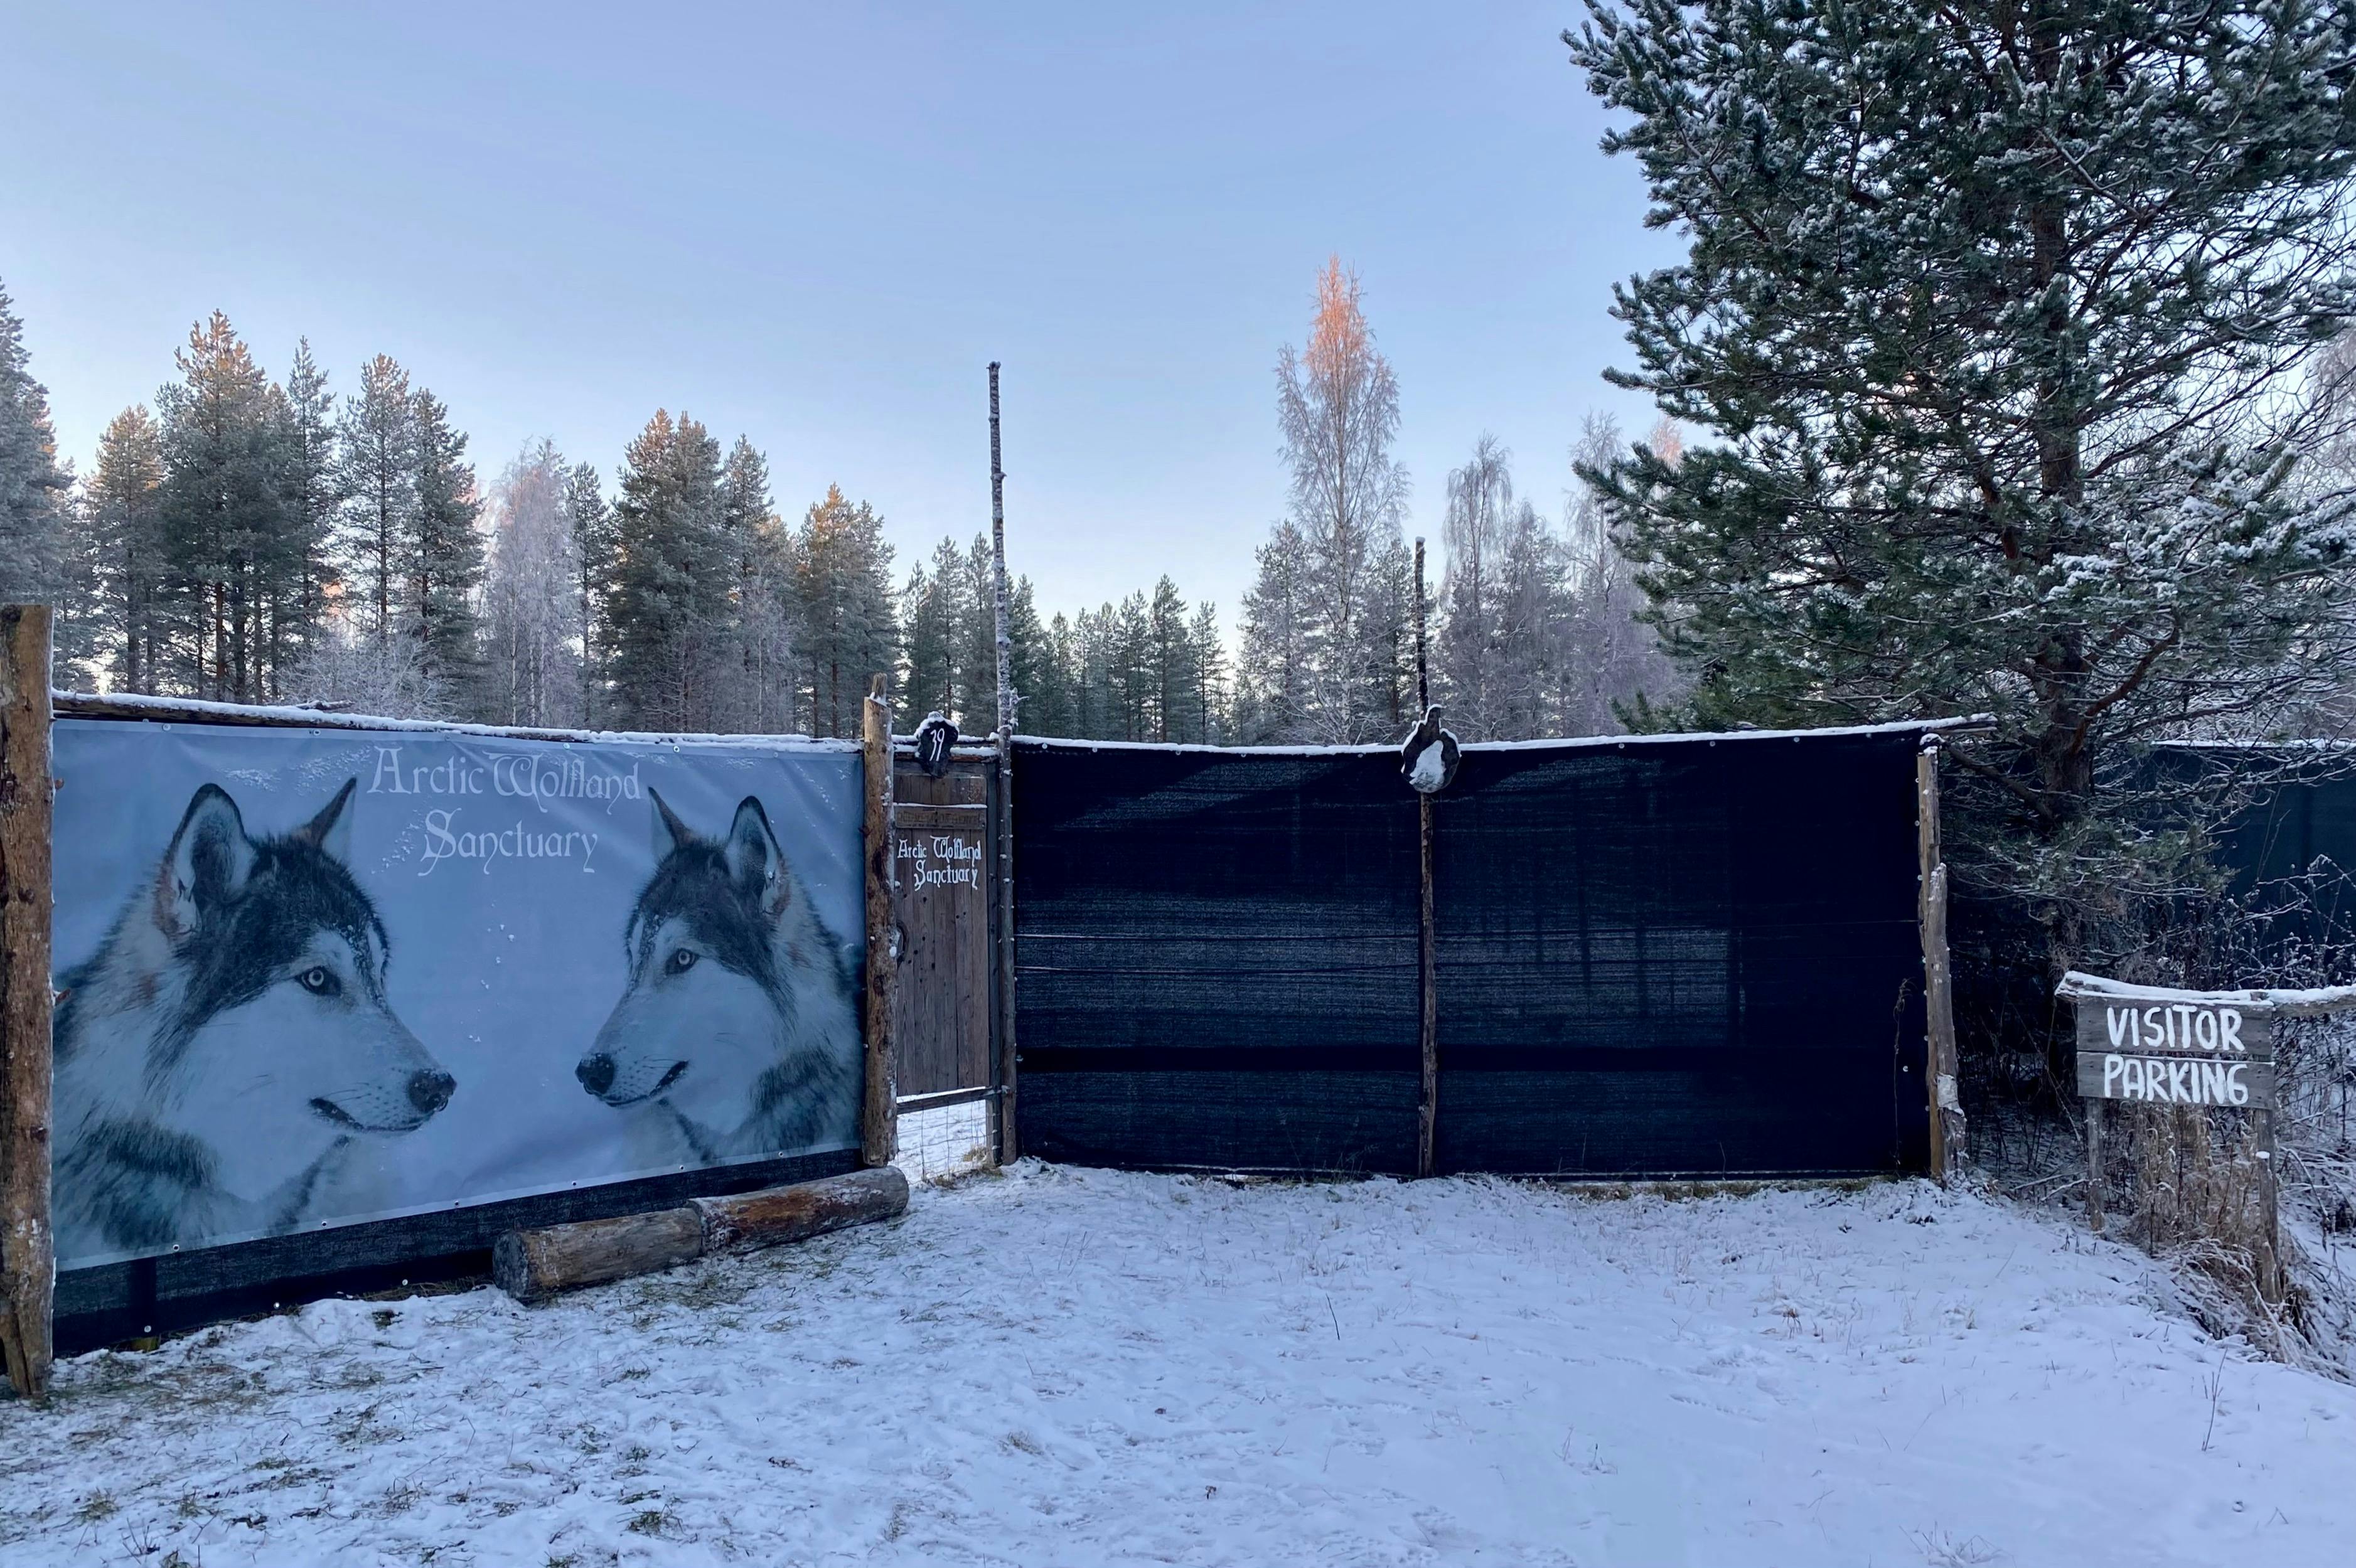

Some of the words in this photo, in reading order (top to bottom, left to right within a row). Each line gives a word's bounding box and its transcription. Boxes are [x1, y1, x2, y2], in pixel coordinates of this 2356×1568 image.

[367, 746, 485, 795] Arctic
[482, 751, 643, 815] Wolfland
[417, 808, 598, 877] Sanctuary
[897, 839, 927, 858] Arctic
[929, 835, 982, 867] Wolfland
[914, 860, 978, 892] Sanctuary
[2107, 1004, 2246, 1052] VISITOR
[2104, 1053, 2249, 1105] PARKING
